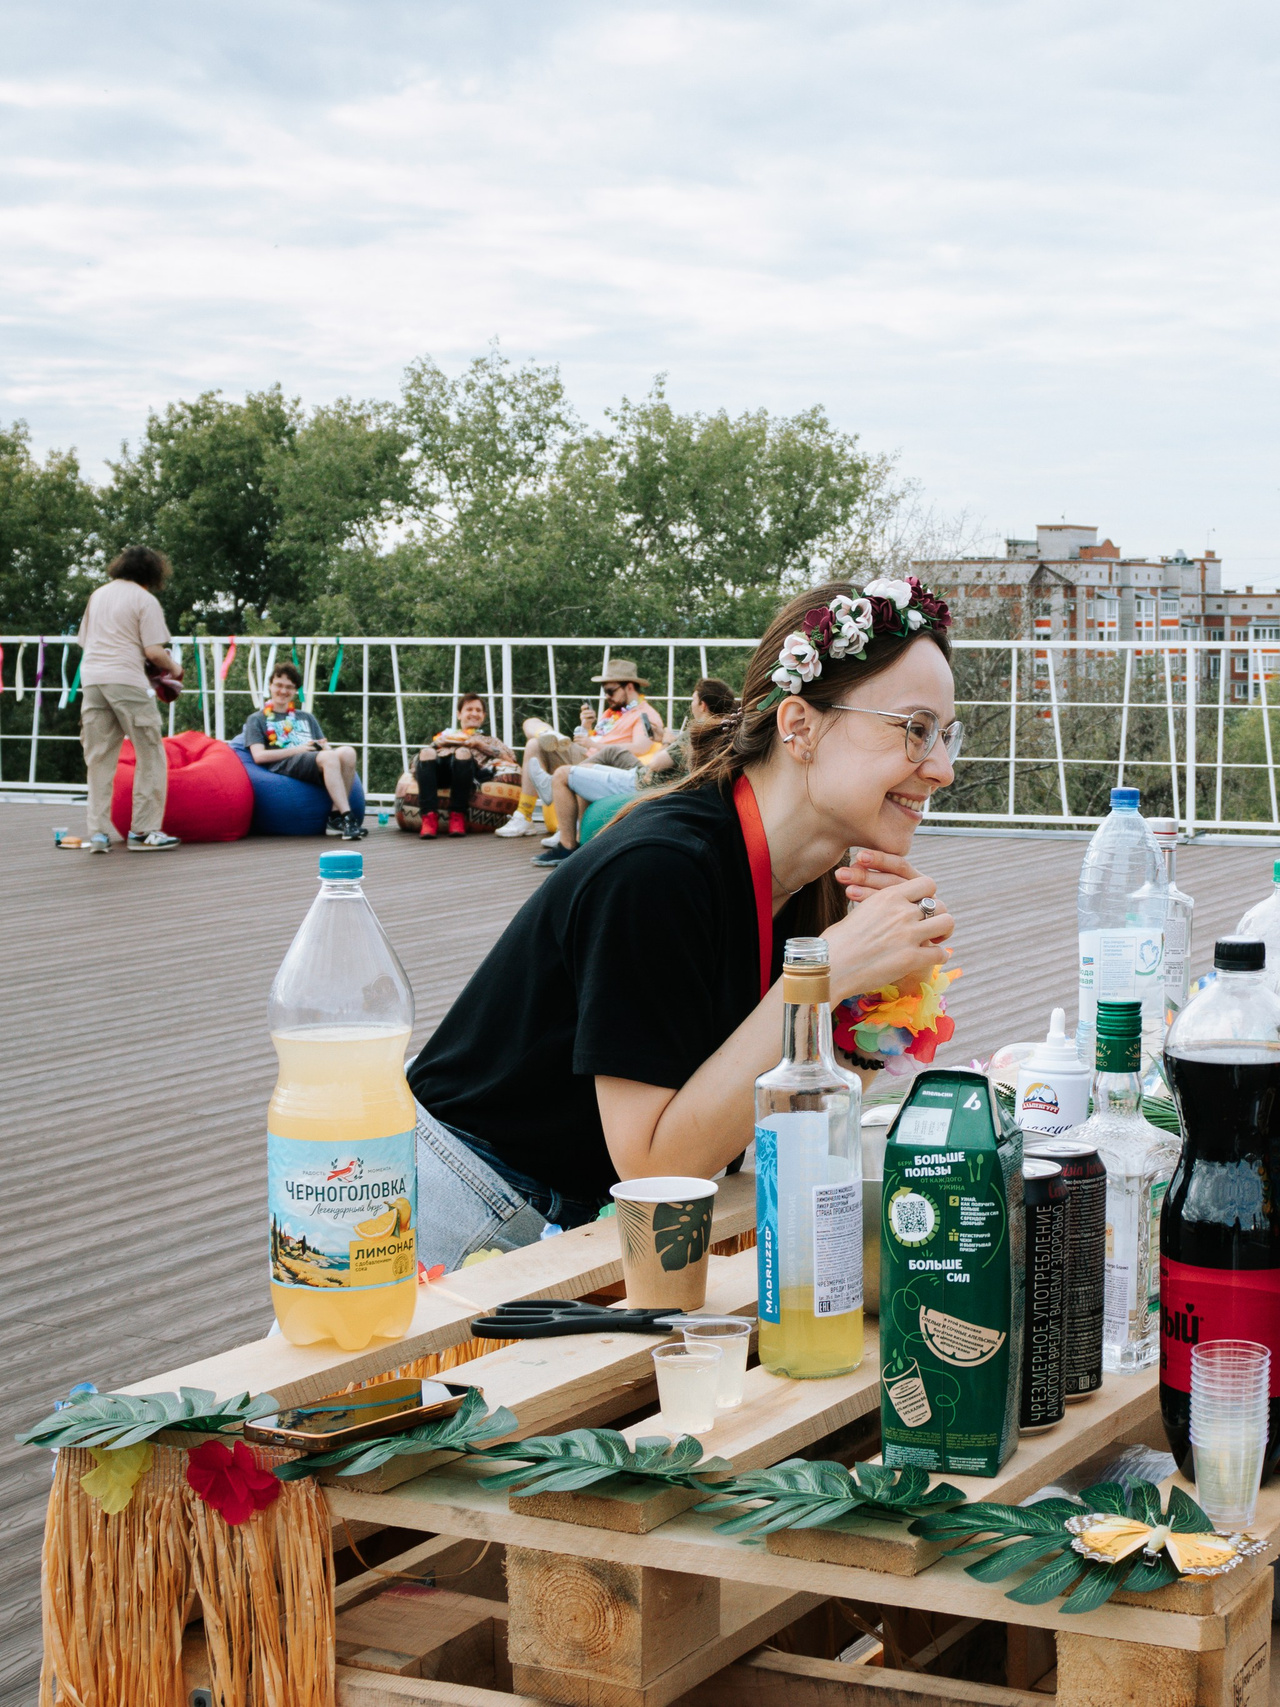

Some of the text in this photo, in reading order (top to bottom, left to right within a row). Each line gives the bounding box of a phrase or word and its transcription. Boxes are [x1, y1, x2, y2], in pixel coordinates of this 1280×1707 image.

[921, 1090, 954, 1098] апельсин
[914, 1151, 966, 1166] БОЛЬШЕ
[367, 1166, 392, 1174] МОМЕНТА
[904, 1165, 952, 1178] ПОЛЬЗЫ
[285, 1177, 407, 1202] ЧЕРНОГОЛОВКА
[309, 1199, 384, 1220] Легендарный вкус
[354, 1237, 414, 1260] ЛИМОНАД
[765, 1229, 773, 1314] MADRUZZO
[908, 1258, 963, 1271] БОЛЬШЕ
[946, 1272, 971, 1283] СИЛ
[1049, 1269, 1063, 1317] ВАШЕМУ
[1030, 1204, 1052, 1422] ЧРЕЗМЕРНОЕ УПОТРЕБЛЕНИЕ
[1048, 1319, 1062, 1360] ВРЕДИТ
[1046, 1360, 1059, 1418] АЛКОГОЛЯ
